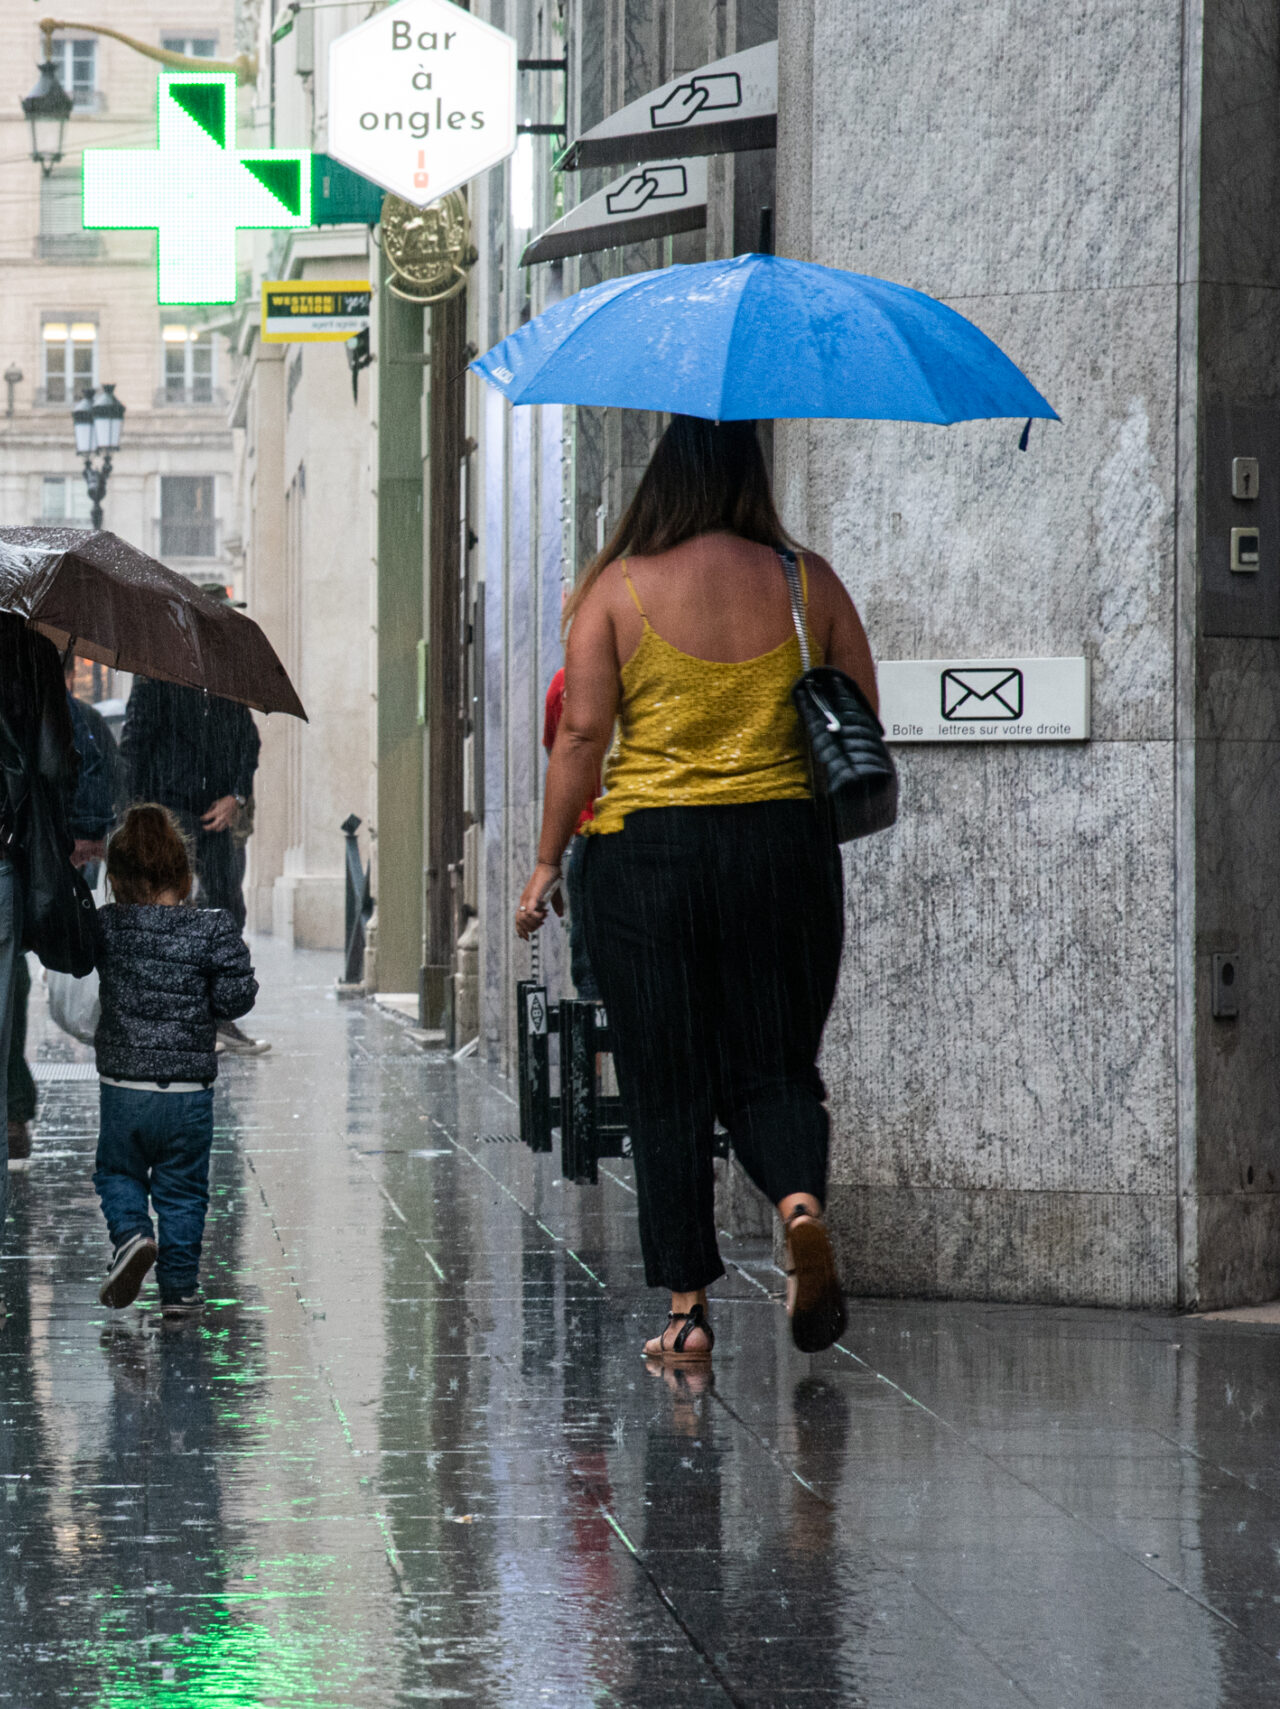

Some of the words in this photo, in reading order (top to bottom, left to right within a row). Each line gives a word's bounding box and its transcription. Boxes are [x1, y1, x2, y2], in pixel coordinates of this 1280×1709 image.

[391, 20, 457, 51] Bar
[411, 64, 432, 91] à
[359, 97, 486, 139] ongles
[272, 295, 334, 306] WESTERN
[290, 304, 334, 314] UNION
[892, 724, 924, 736] Boîte
[938, 724, 975, 736] lettres
[979, 726, 998, 736] sur
[1002, 724, 1033, 736] votre
[1036, 723, 1071, 735] droite
